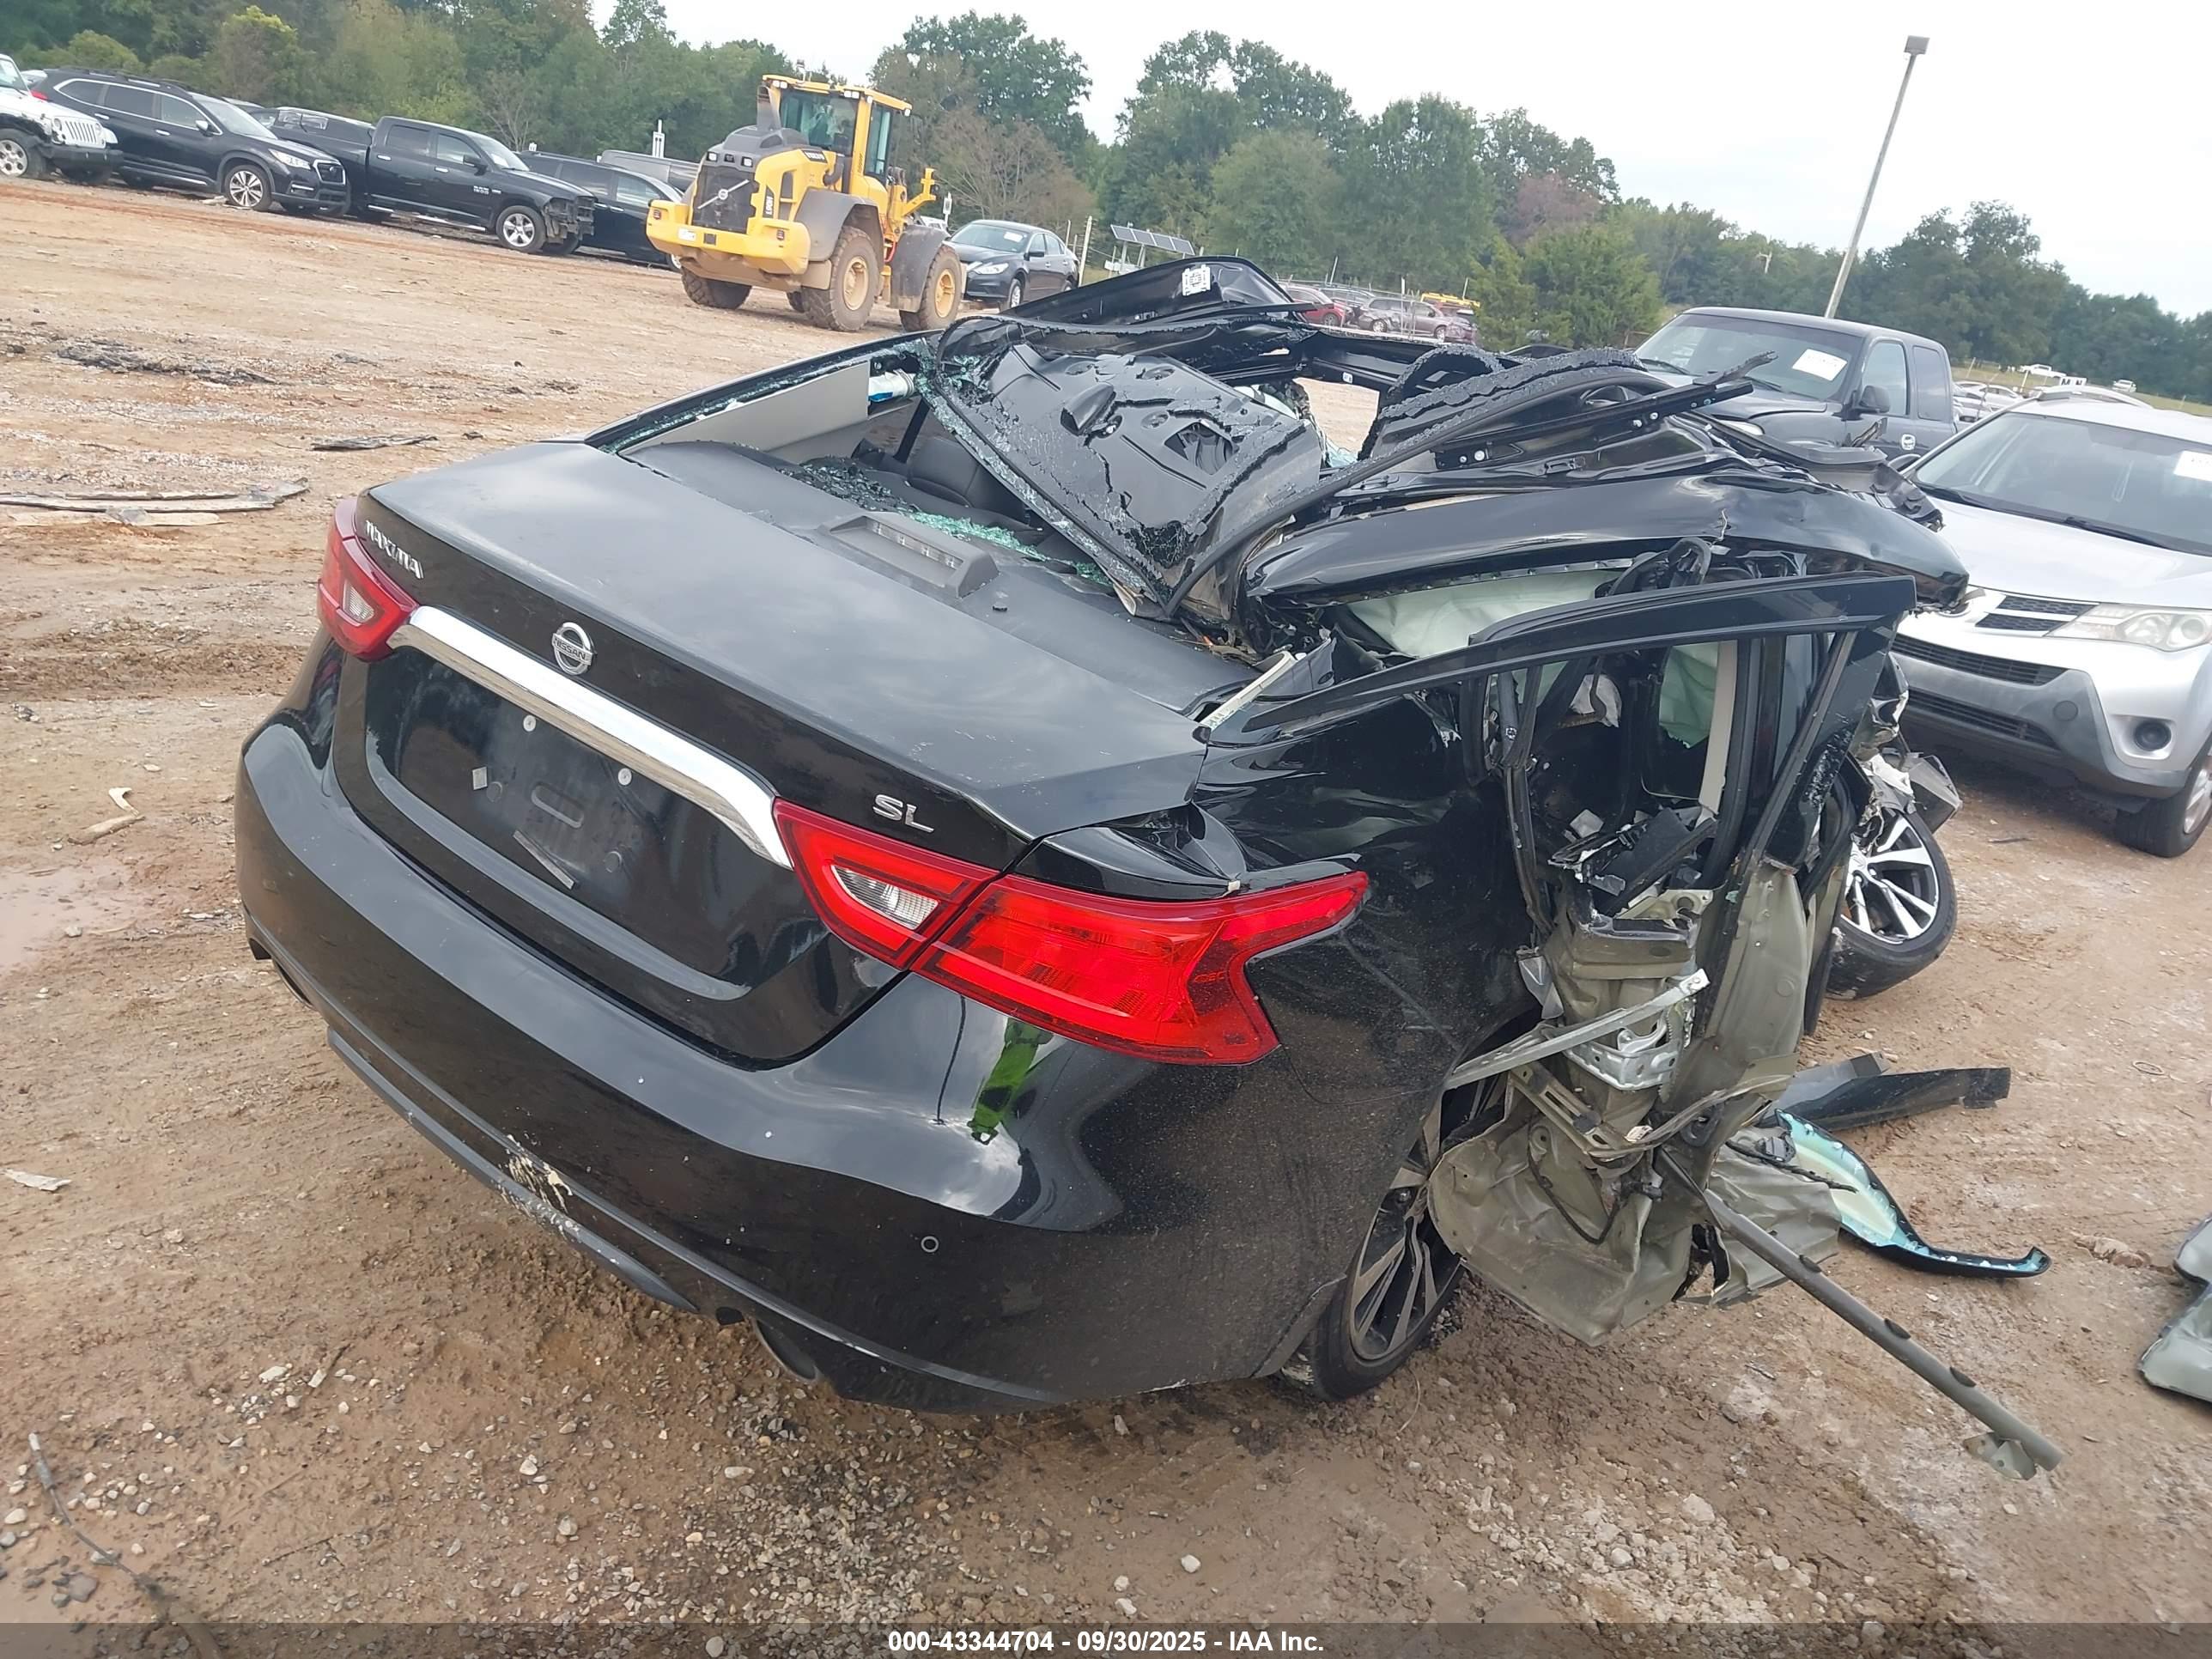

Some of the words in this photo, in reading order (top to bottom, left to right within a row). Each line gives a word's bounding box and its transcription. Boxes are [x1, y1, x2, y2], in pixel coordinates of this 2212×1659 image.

[365, 519, 424, 580] MAXIMA
[554, 636, 586, 661] NISSAN
[872, 793, 935, 833] SL
